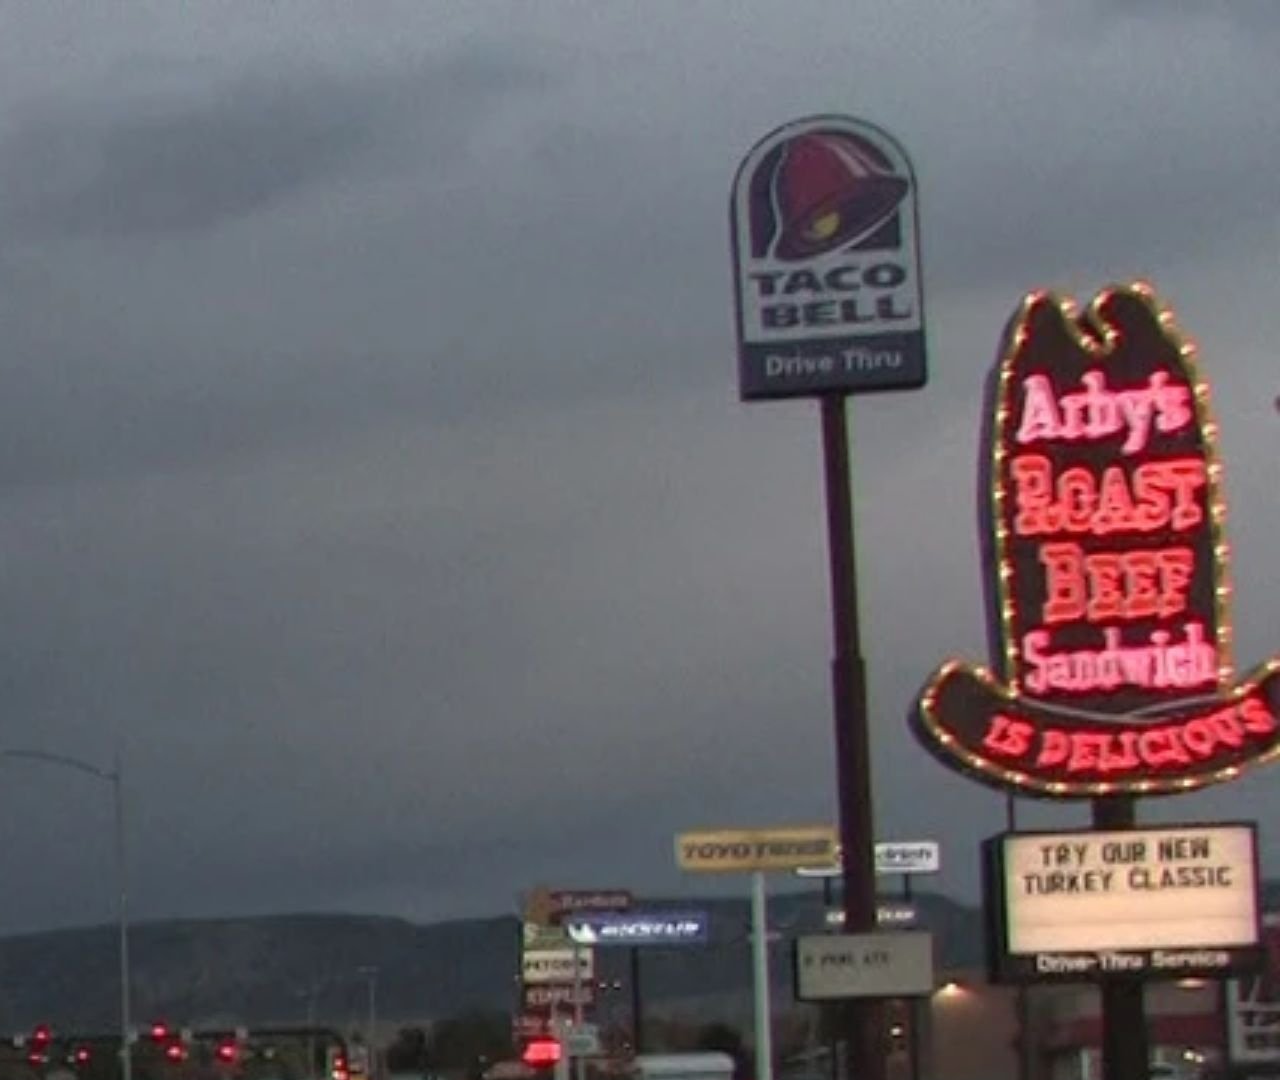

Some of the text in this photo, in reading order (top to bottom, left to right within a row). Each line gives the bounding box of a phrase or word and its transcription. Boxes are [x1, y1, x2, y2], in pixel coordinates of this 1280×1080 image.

[749, 263, 906, 297] TACO
[761, 295, 912, 330] BELL
[766, 350, 902, 377] Drive Thru
[1016, 370, 1191, 454] Arby's
[1011, 454, 1205, 534] ROAST
[1040, 542, 1195, 623] BEEF
[1022, 623, 1217, 693] Sandwich
[984, 697, 1275, 772] IS DELICIOUS
[1041, 837, 1210, 867] TRY OUR NEW
[1023, 866, 1233, 895] TURKEY CLASSIC
[1151, 949, 1230, 969] Service
